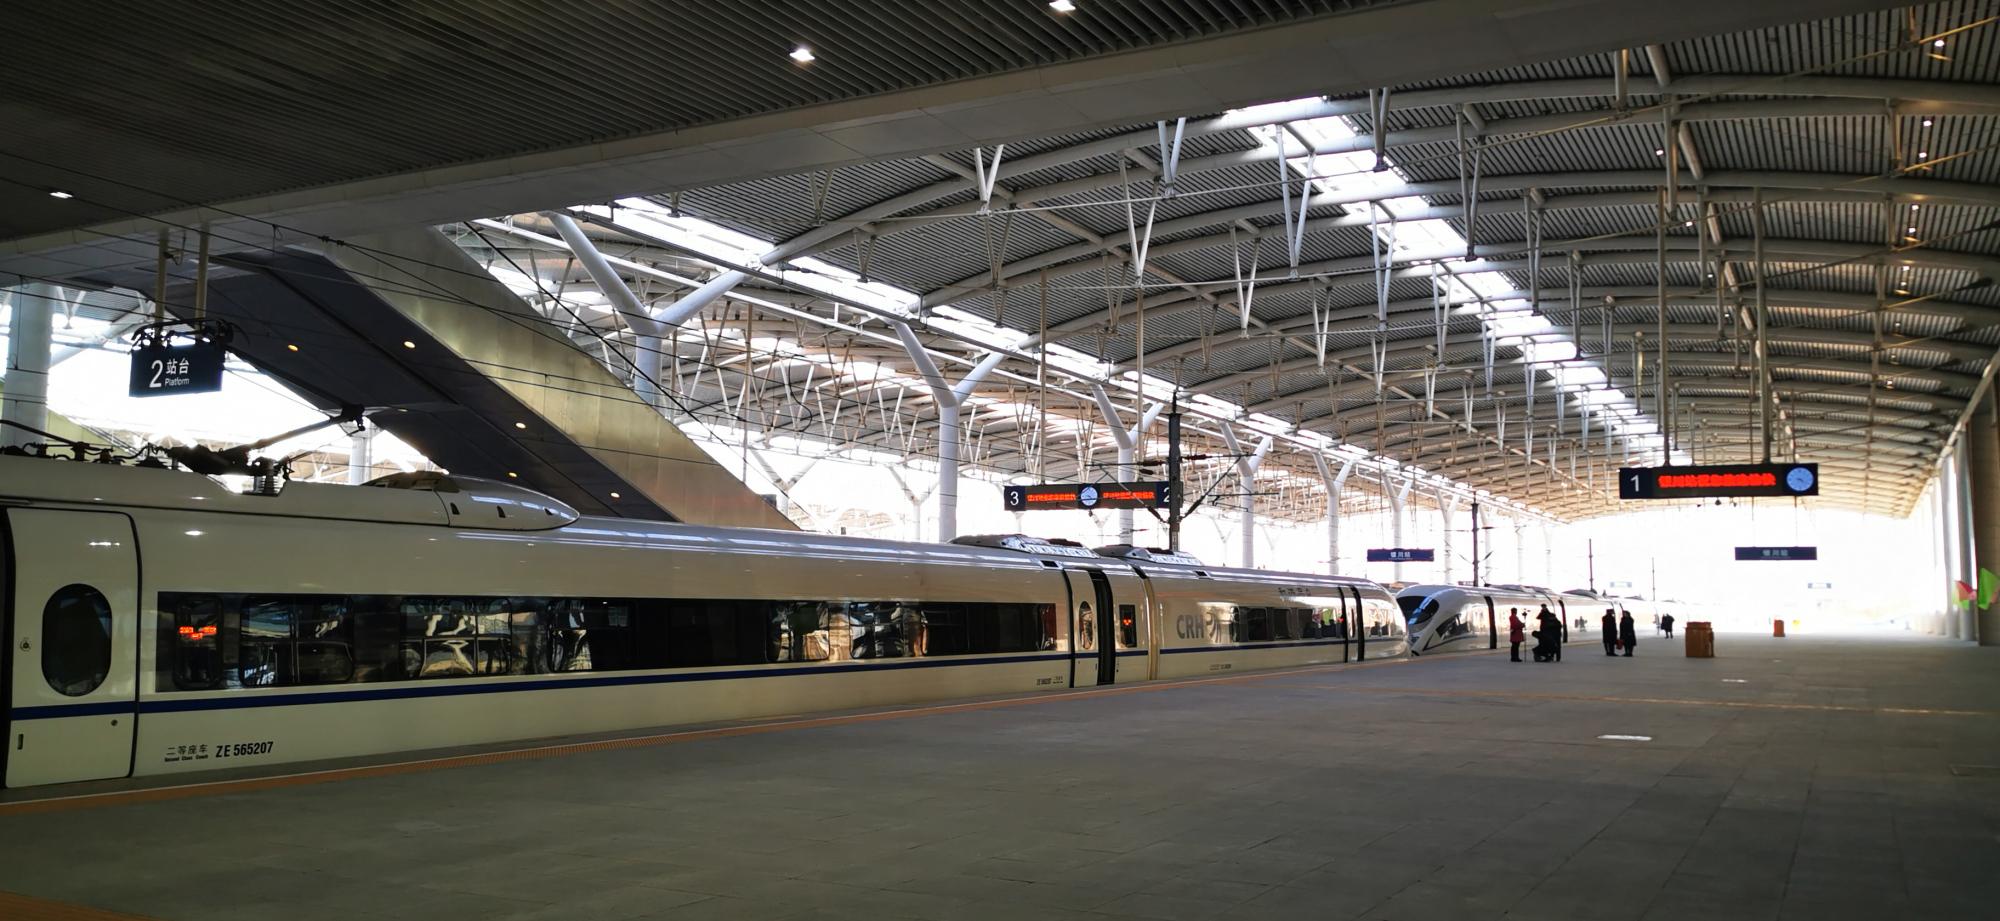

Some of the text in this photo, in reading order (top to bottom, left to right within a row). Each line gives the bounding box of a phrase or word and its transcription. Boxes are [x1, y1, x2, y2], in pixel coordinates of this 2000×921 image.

[149, 360, 163, 388] 2
[166, 358, 189, 375] 站台
[164, 377, 190, 387] Platform
[1630, 474, 1640, 492] 1
[1010, 490, 1019, 506] 3
[1163, 487, 1170, 502] 2
[1176, 614, 1204, 639] CRH
[166, 744, 208, 755] 二等座车
[215, 741, 274, 758] ZE 565207
